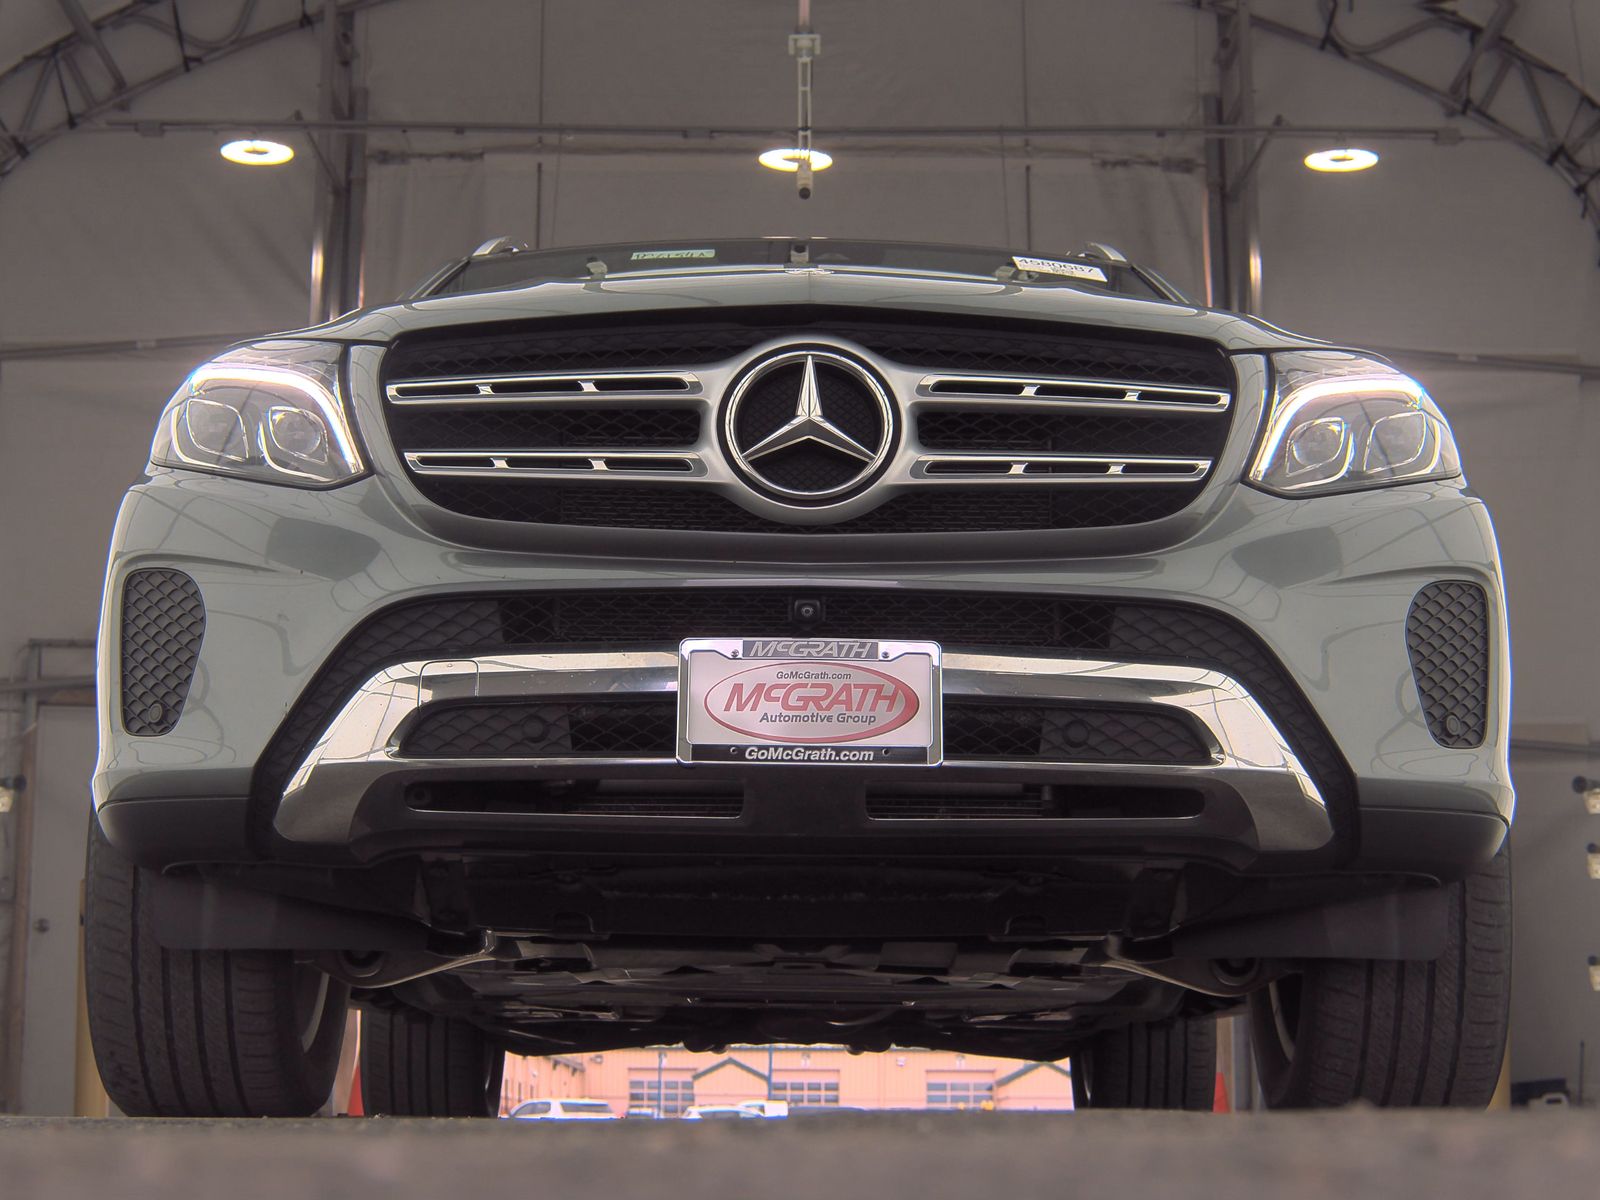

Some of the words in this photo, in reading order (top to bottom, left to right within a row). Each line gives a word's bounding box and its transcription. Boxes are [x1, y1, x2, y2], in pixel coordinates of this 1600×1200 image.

[776, 671, 852, 680] GoMcGrath.com
[723, 683, 900, 712] McGRATH
[759, 712, 834, 724] Automotive
[836, 713, 877, 725] Group
[745, 746, 875, 761] GoMcGrath.com
